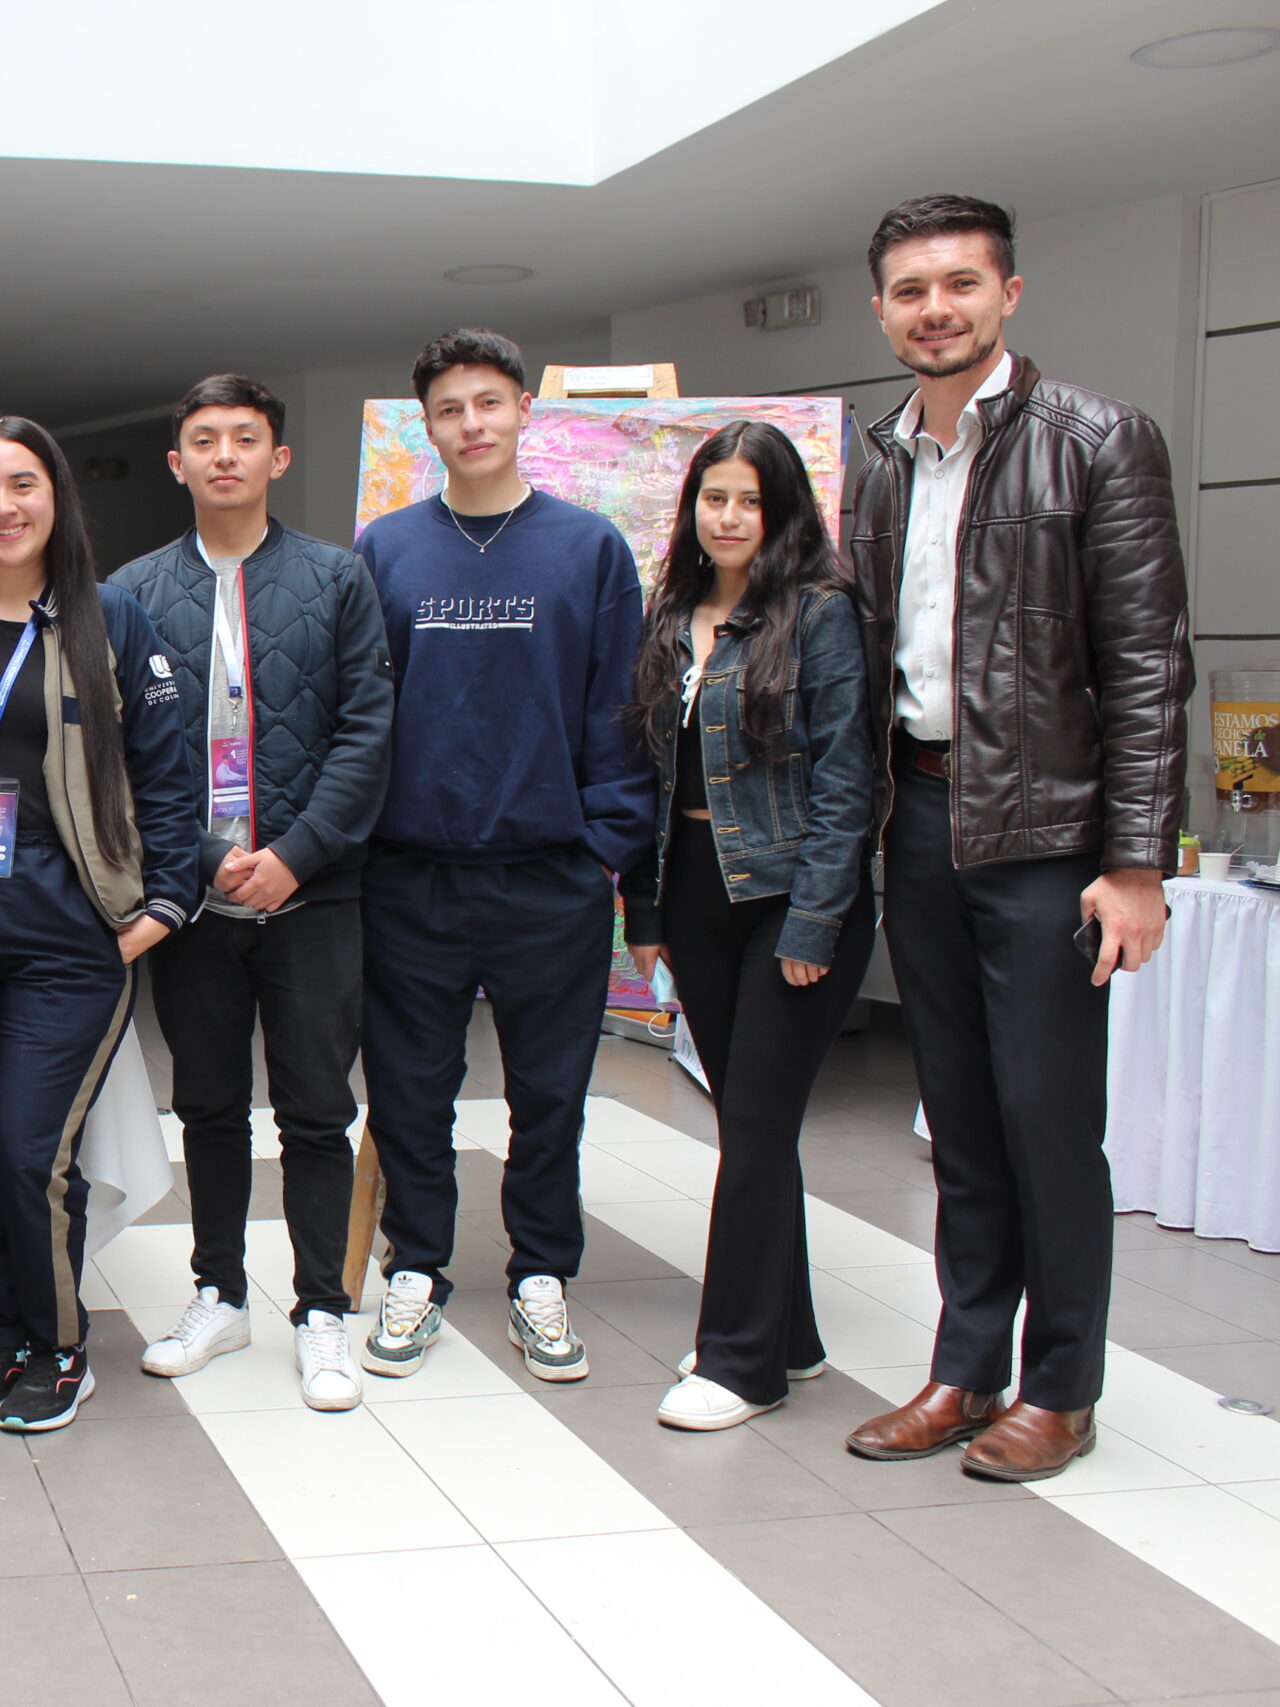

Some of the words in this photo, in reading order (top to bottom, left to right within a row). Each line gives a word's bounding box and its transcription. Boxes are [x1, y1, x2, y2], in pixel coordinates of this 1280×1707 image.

[415, 596, 535, 621] SPORTS
[1214, 712, 1278, 728] ESTAMOS
[1254, 730, 1266, 740] de
[1213, 739, 1269, 758] PANELA
